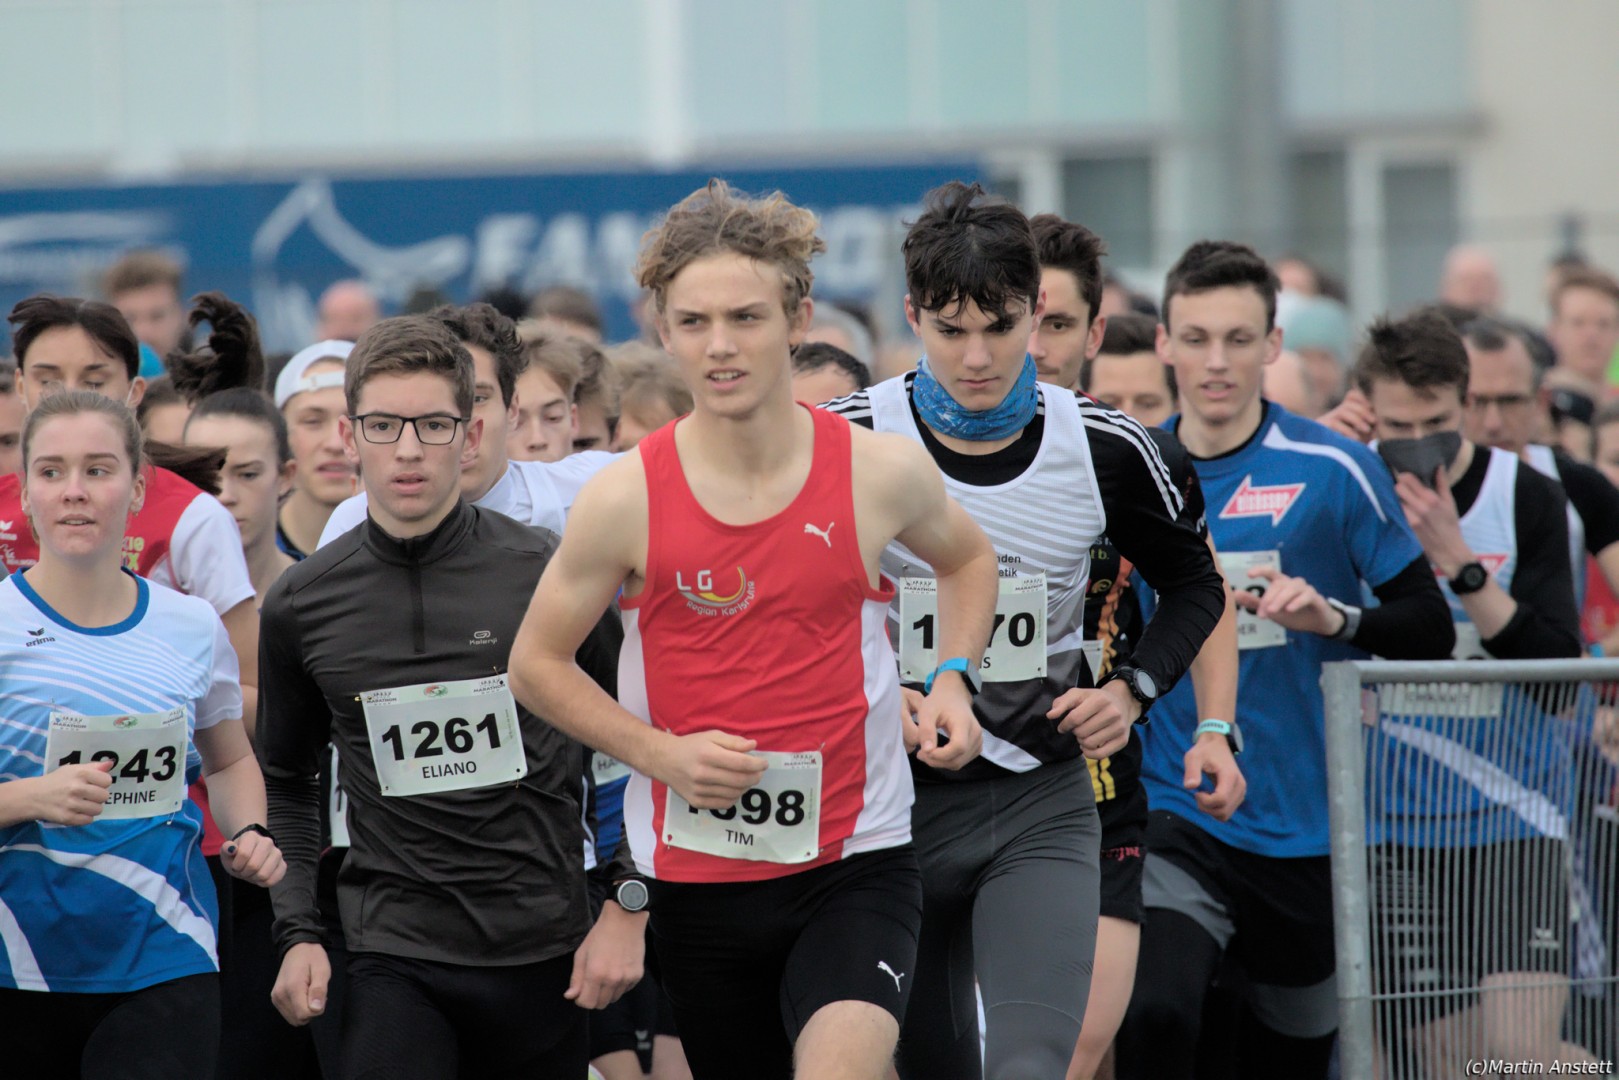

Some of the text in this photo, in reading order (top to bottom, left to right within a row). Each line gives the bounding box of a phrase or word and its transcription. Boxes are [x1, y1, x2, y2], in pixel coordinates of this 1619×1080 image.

[686, 580, 755, 617] Region Karlsruhe
[25, 636, 56, 648] erima
[912, 611, 1036, 650] 170
[381, 712, 502, 762] 1261
[421, 760, 478, 780] ELIANO
[725, 829, 754, 847] TIM
